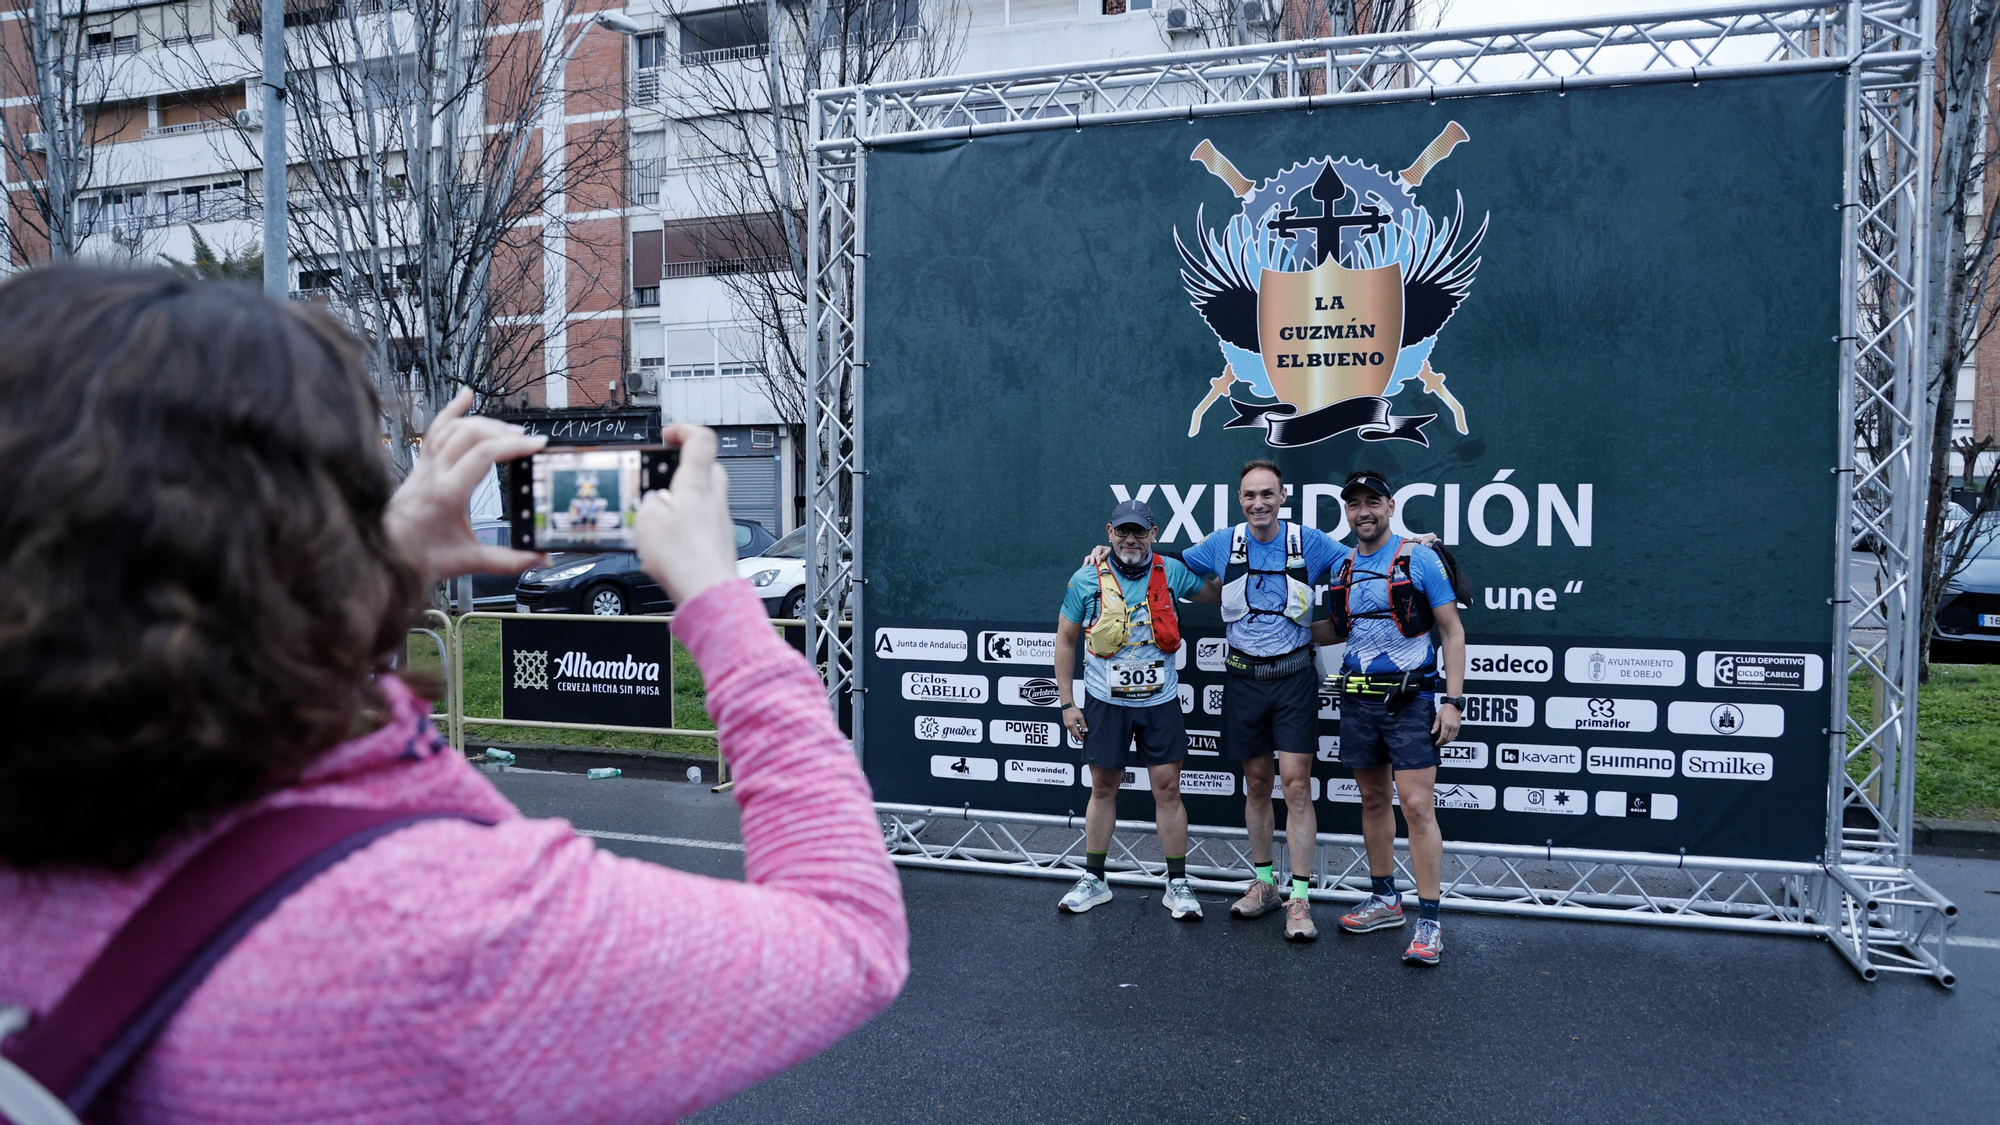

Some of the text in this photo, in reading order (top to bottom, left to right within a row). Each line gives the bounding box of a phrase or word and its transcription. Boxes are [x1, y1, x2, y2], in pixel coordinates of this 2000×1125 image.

[1315, 296, 1345, 311] LA
[1279, 318, 1376, 340] GUZMÁN
[1283, 469, 1593, 547] DCIÓN
[896, 640, 967, 650] Junta de Andalucía
[1016, 637, 1055, 648] Diputaci
[1016, 648, 1056, 658] de Córdo
[553, 651, 660, 681] Alhambra
[1470, 653, 1549, 674] sadeco
[1607, 658, 1674, 668] AYUNTAMIENTO
[1735, 656, 1805, 665] CLUB DEPORTIVO
[911, 673, 947, 684] Ciclos
[1119, 668, 1158, 686] 303
[1620, 669, 1663, 679] DE OBEJO
[1737, 670, 1800, 679] CICLOS CABELLO
[557, 681, 660, 696] CERVEZA HECHA SIN PRISA
[911, 684, 981, 699] CABELLO
[1440, 696, 1518, 723] 6ERS
[1005, 722, 1048, 735] POWER
[1575, 718, 1631, 730] primaflor
[941, 725, 978, 739] guadex
[1024, 734, 1049, 745] ADE
[1440, 747, 1469, 758] FIX
[1522, 751, 1576, 764] kavant
[1590, 754, 1673, 771] SHIMANO
[1688, 757, 1766, 776] Smilke
[1181, 772, 1231, 781] OMECÁNICA
[1180, 780, 1222, 788] ALENTÍN
